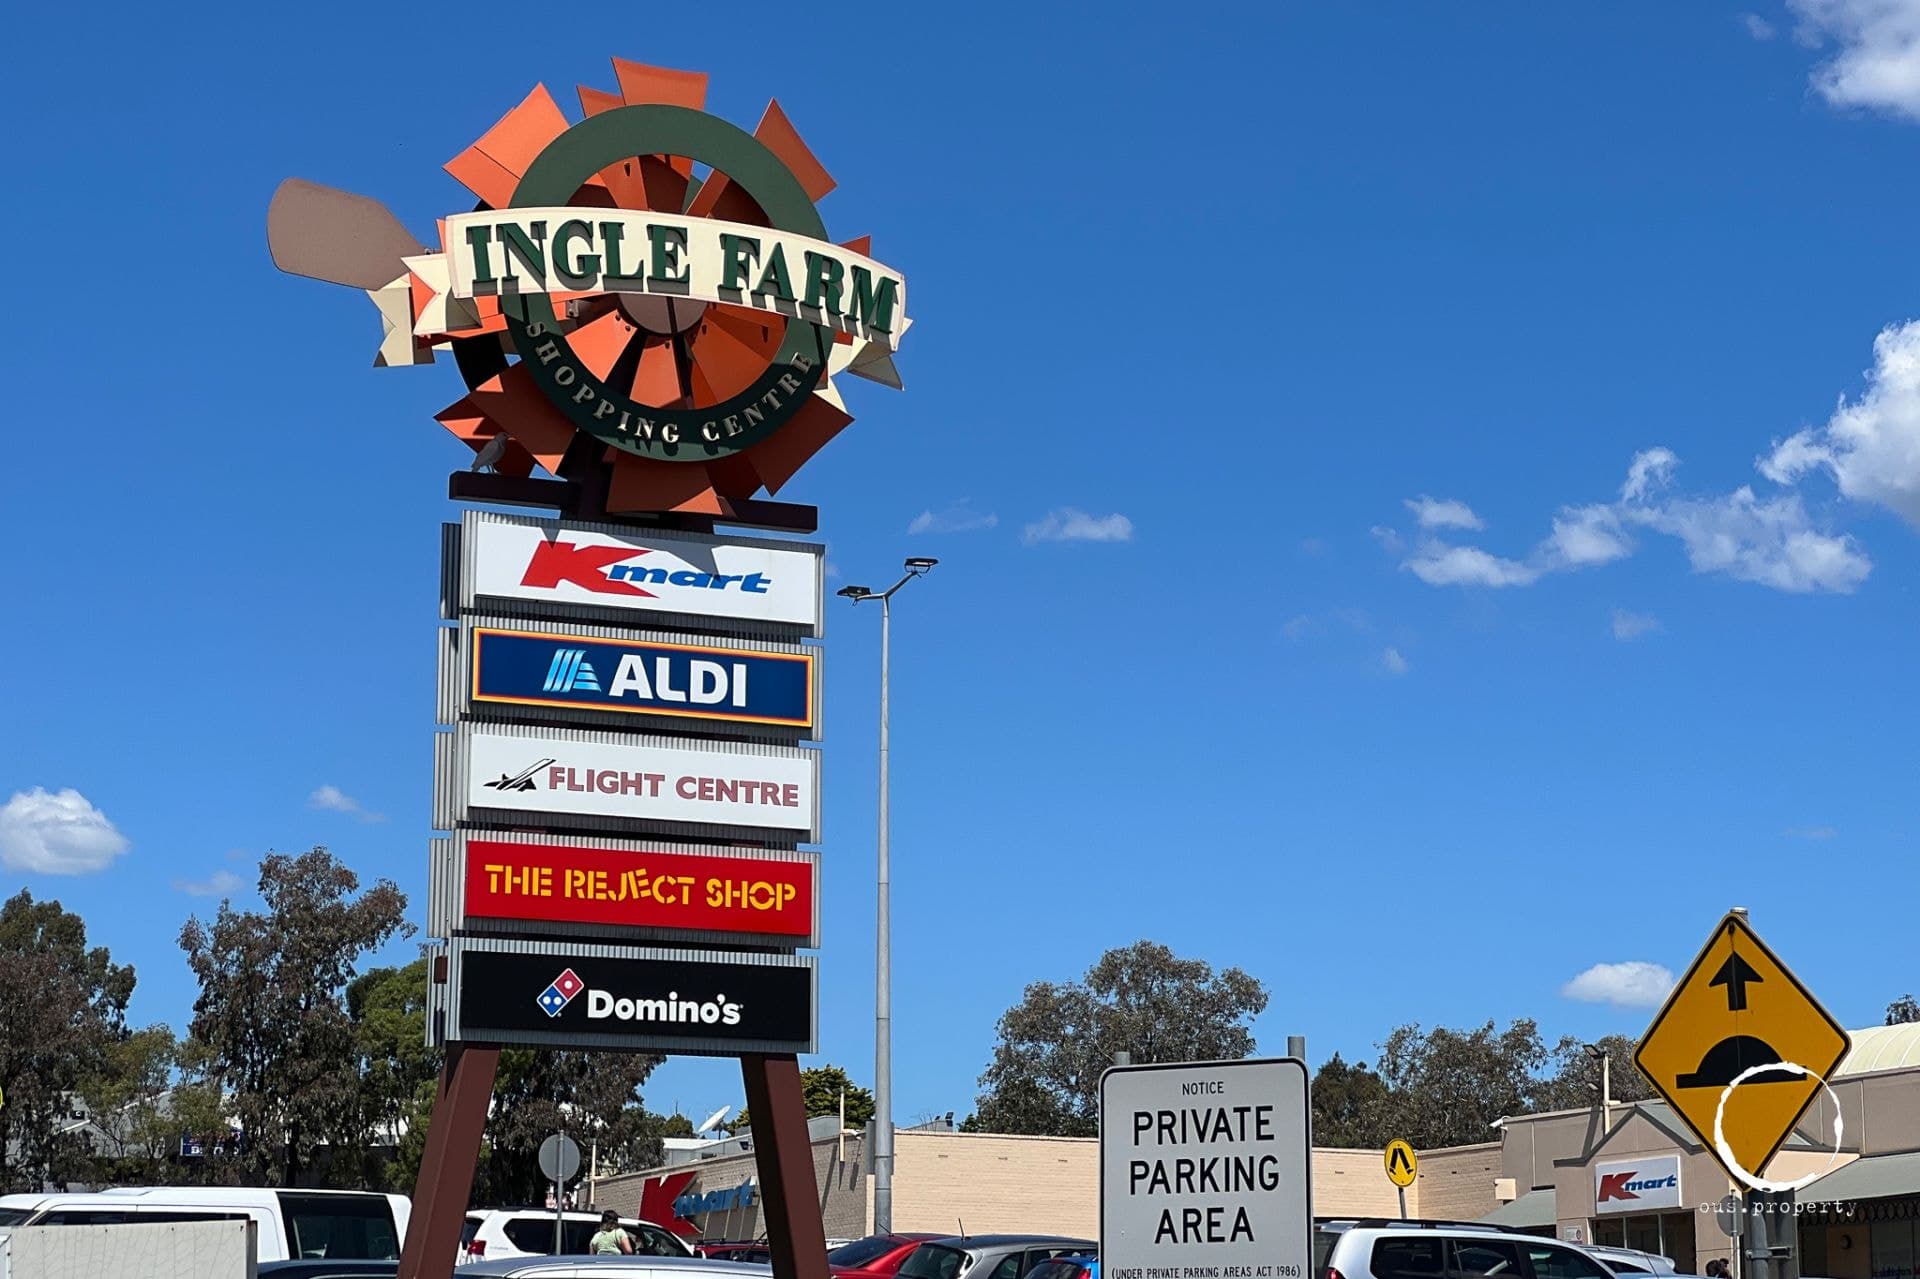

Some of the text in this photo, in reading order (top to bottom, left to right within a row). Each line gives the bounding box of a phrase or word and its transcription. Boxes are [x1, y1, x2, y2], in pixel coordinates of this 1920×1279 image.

[466, 218, 901, 335] INGLE FARM
[525, 320, 814, 444] SHOPPING CENTRE
[519, 540, 772, 599] Kmart
[608, 653, 747, 707] ALDI
[549, 766, 799, 807] FLIGHT CENTRE
[484, 864, 796, 911] THE REJECT SHOP
[587, 989, 741, 1025] Domino's
[1182, 1081, 1225, 1096] NOTICE
[1133, 1105, 1275, 1146] PRIVATE
[1130, 1154, 1280, 1195] PARKING
[1598, 1171, 1677, 1202] Kmart
[1154, 1206, 1255, 1244] AREA
[1111, 1264, 1301, 1279] (UNDER PRIVATE PARKING AREAS ACT 1986)
